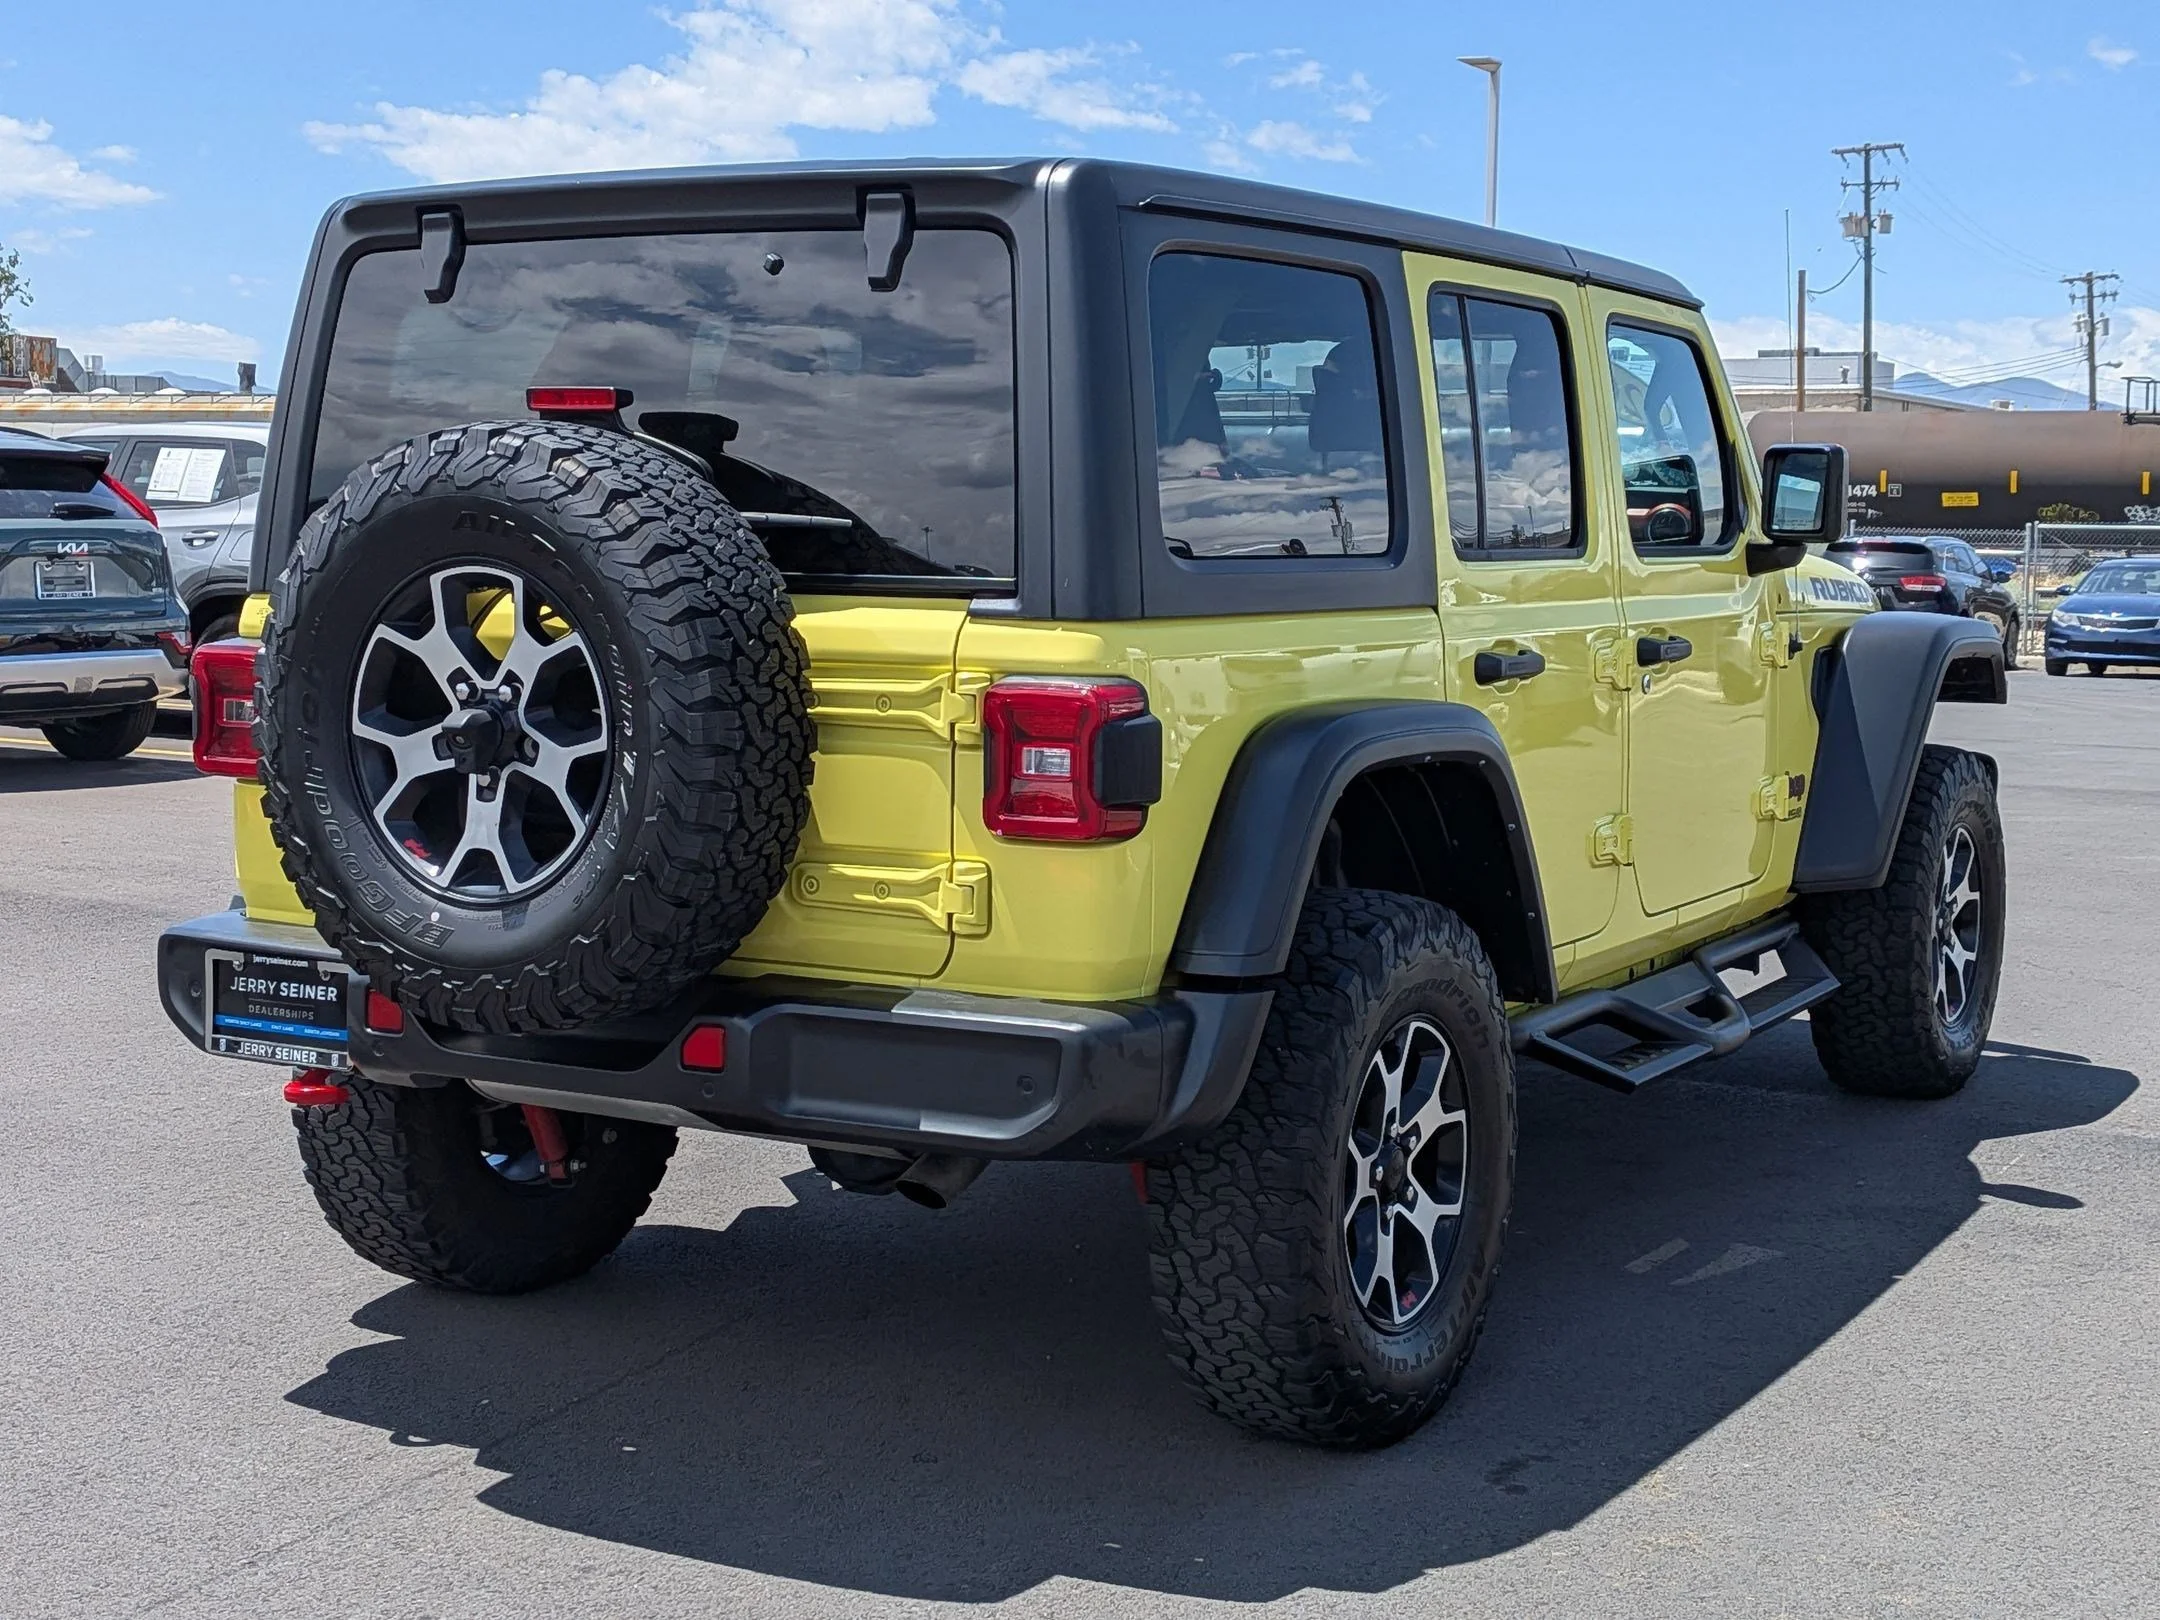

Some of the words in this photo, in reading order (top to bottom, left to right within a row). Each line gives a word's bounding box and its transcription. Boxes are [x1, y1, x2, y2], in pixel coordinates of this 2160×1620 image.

[57, 542, 89, 554] KIA
[230, 976, 277, 995] JERRY
[279, 981, 338, 1001] SEINER
[248, 1004, 315, 1020] DEALERSHIPS
[237, 1041, 274, 1057] JERRY
[275, 1047, 318, 1064] SEINER
